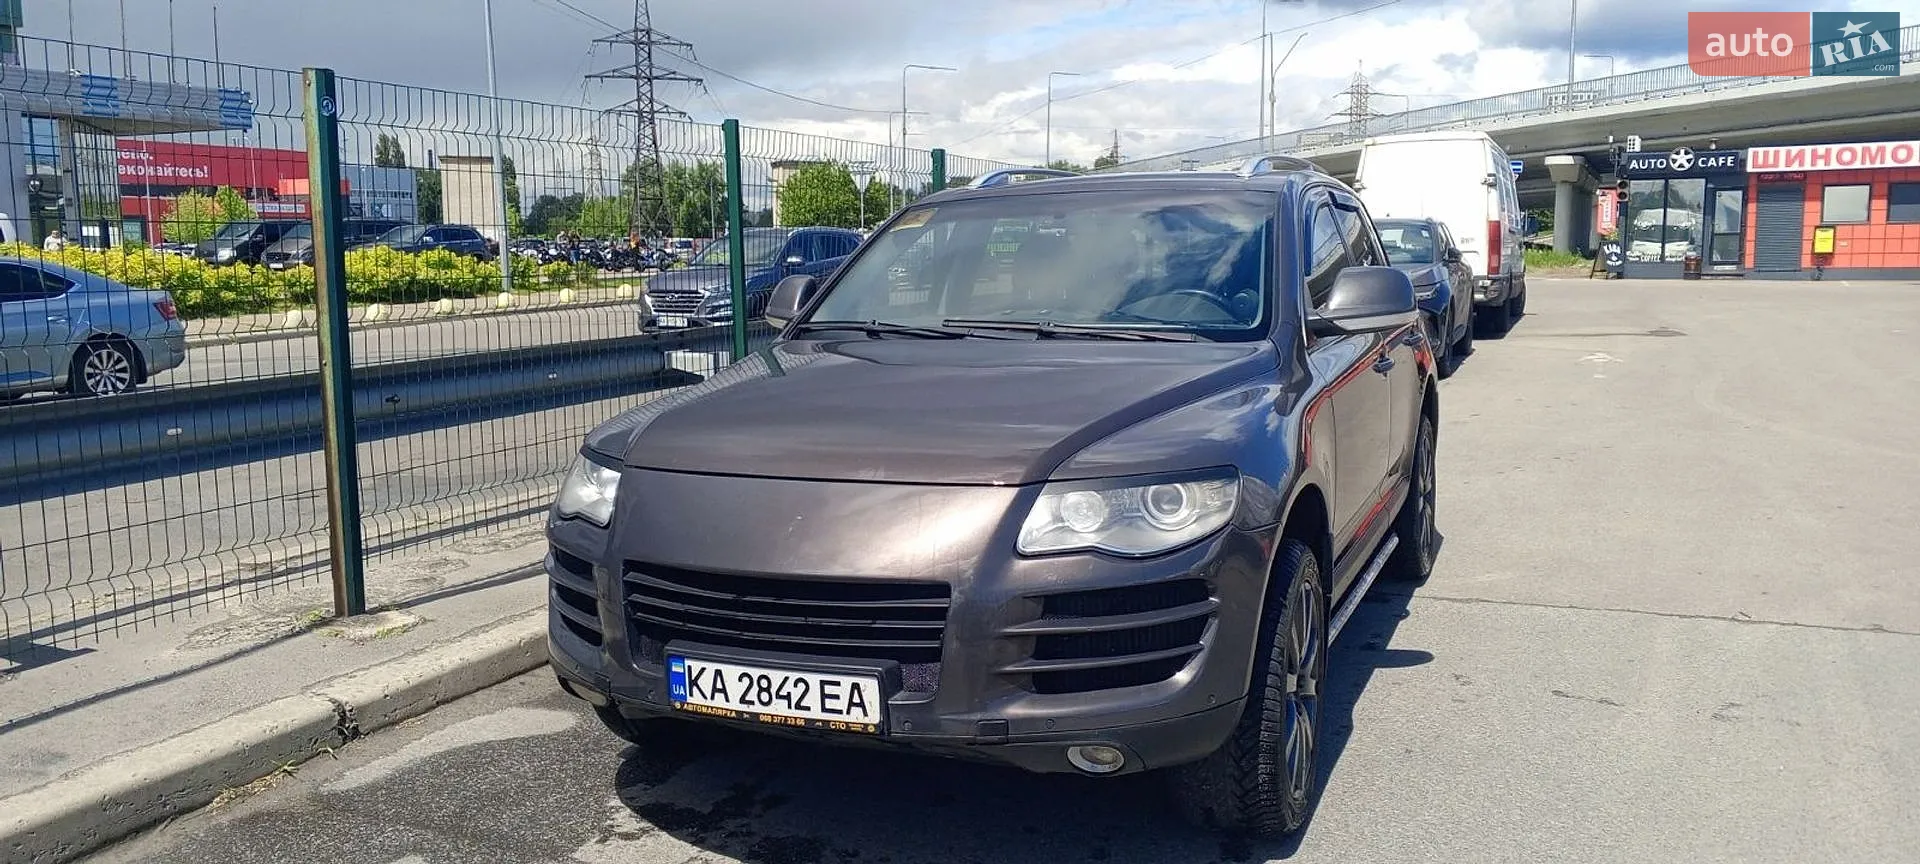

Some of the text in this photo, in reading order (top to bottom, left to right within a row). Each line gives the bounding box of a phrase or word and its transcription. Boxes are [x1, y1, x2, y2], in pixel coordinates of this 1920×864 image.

[1629, 156, 1735, 169] AUTO CAFE
[1752, 144, 1920, 169] ШИНОМО
[672, 684, 686, 696] UA
[687, 664, 868, 717] KA 2842 EA
[683, 703, 737, 718] АВТОМАЛЯРКА
[829, 721, 847, 730] СТО
